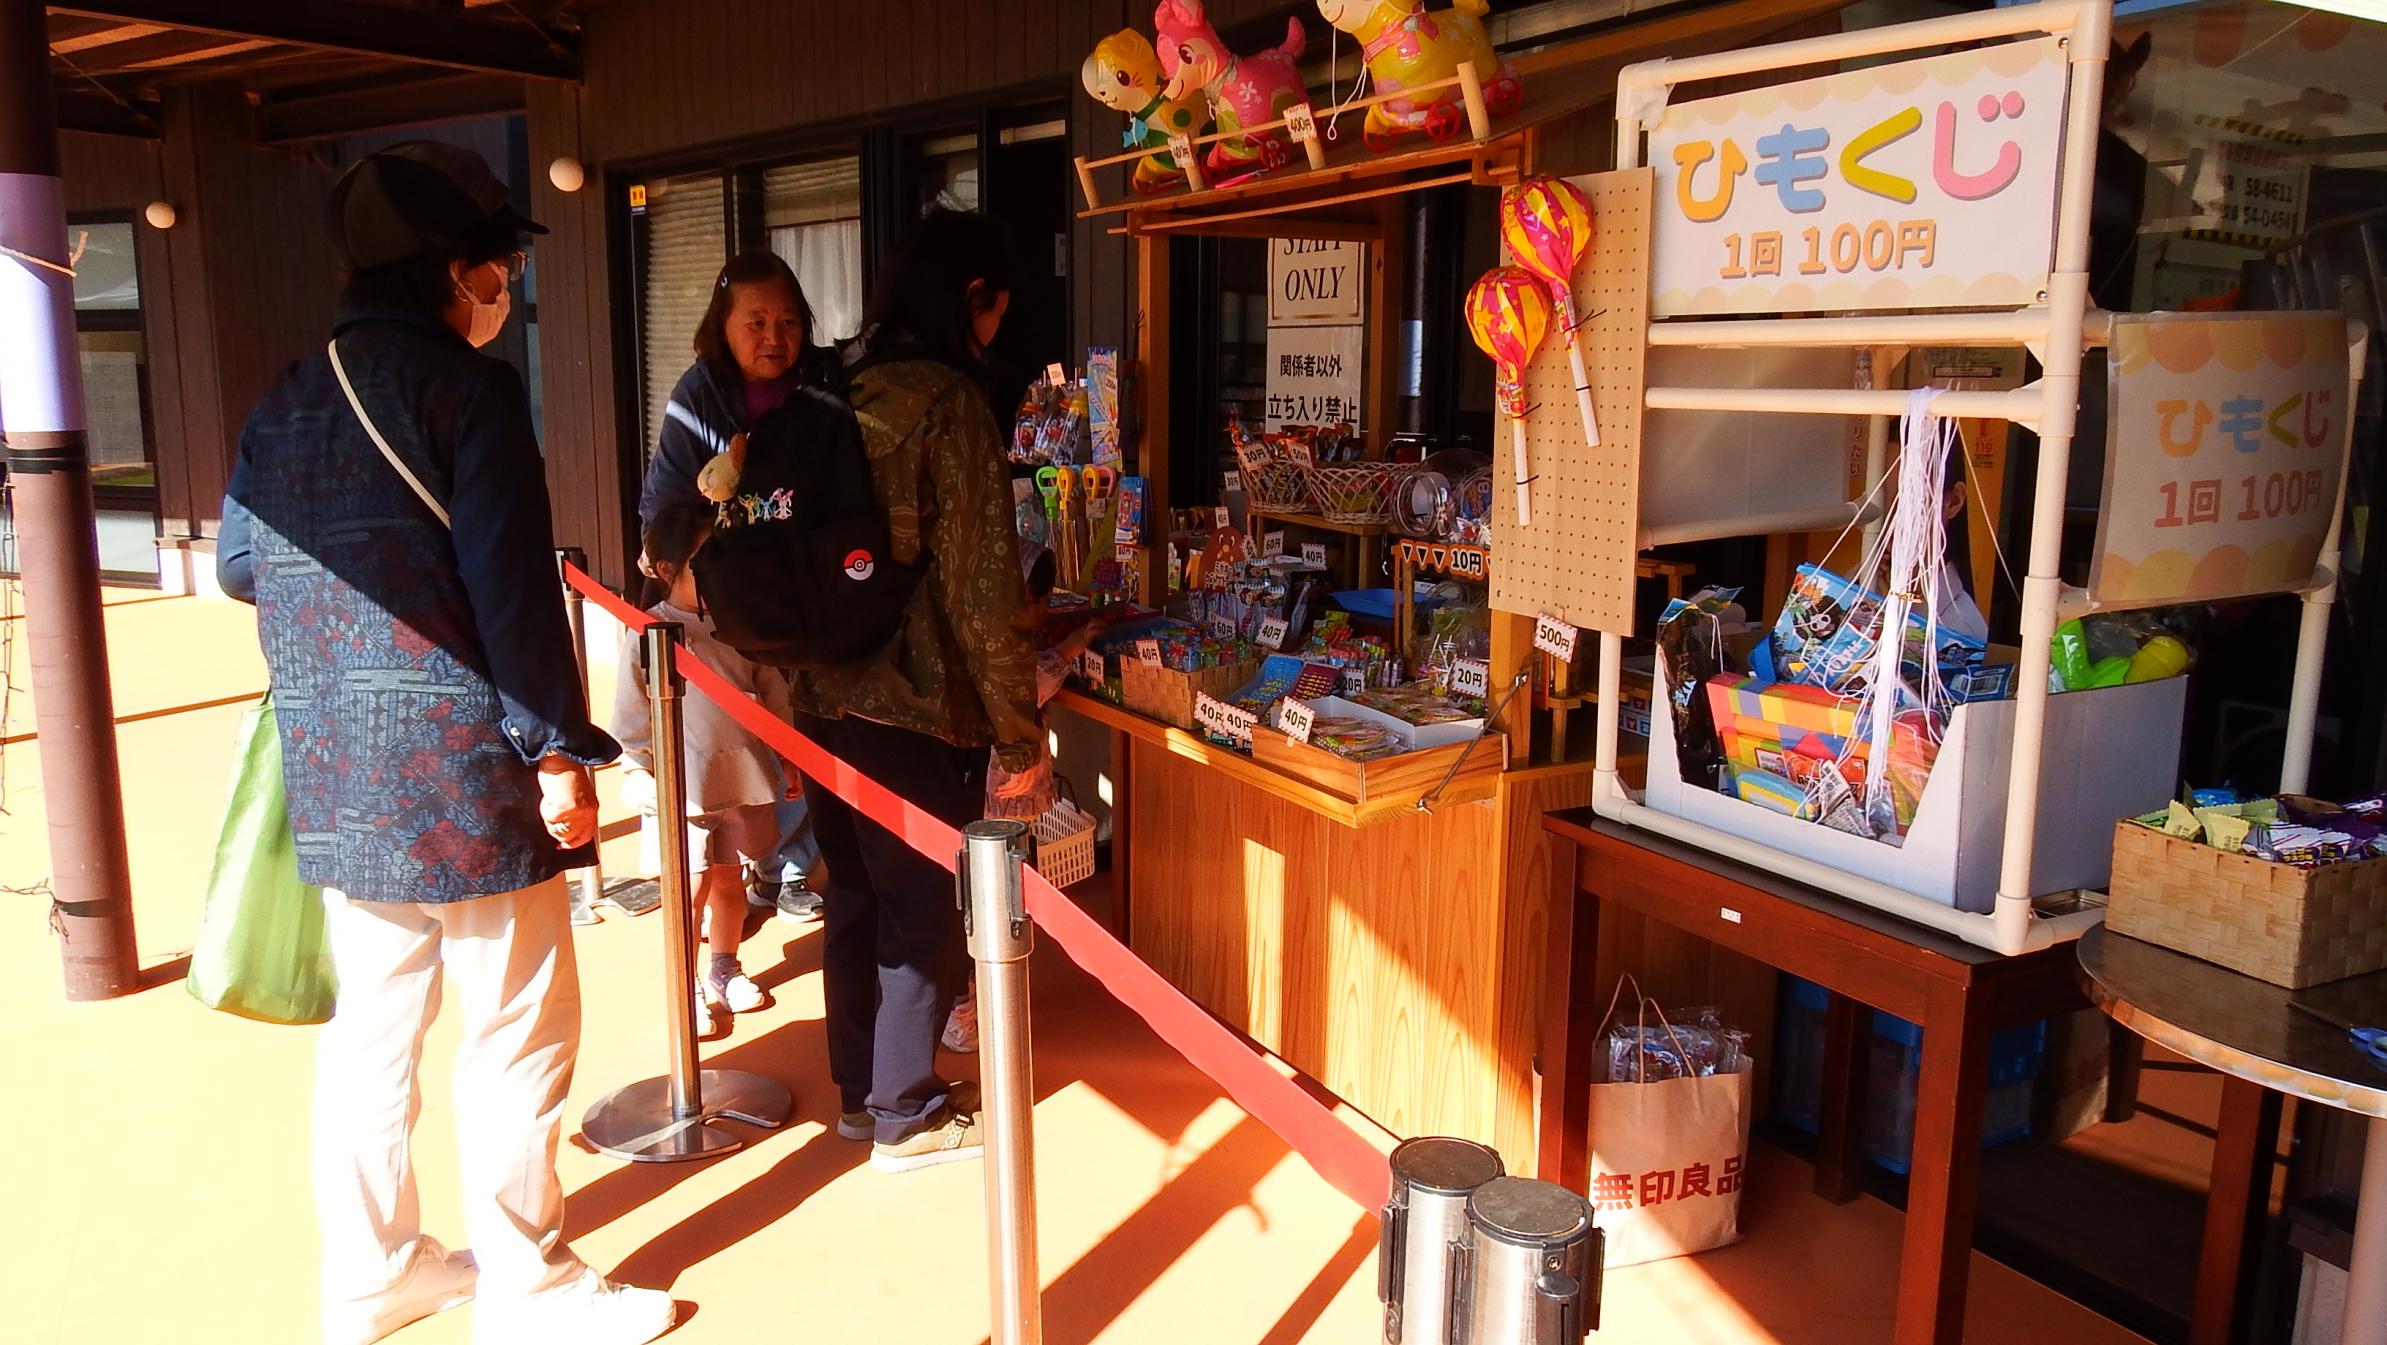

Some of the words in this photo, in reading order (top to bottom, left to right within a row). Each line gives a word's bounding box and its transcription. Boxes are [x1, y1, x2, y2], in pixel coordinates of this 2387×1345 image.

[1673, 90, 2025, 223] ひもくじ
[1719, 230, 1783, 279] 1回
[1797, 218, 1937, 276] 100円
[1284, 265, 1346, 302] ONLY
[1279, 354, 1343, 378] 関係者以外
[1267, 393, 1358, 424] 立ち入り禁止
[2155, 389, 2331, 458] ひもくじ
[1243, 448, 1267, 463] 30円
[2153, 479, 2222, 528] 1回
[2236, 468, 2323, 522] 100円
[1304, 549, 1324, 564] 40円
[1451, 549, 1482, 575] 10円
[1261, 623, 1282, 641] 40円
[1538, 624, 1571, 652] 500円
[1141, 646, 1159, 662] 40円
[1457, 667, 1483, 688] 20円
[1284, 708, 1308, 732] 40円
[1593, 1154, 1743, 1212] 無印良品
